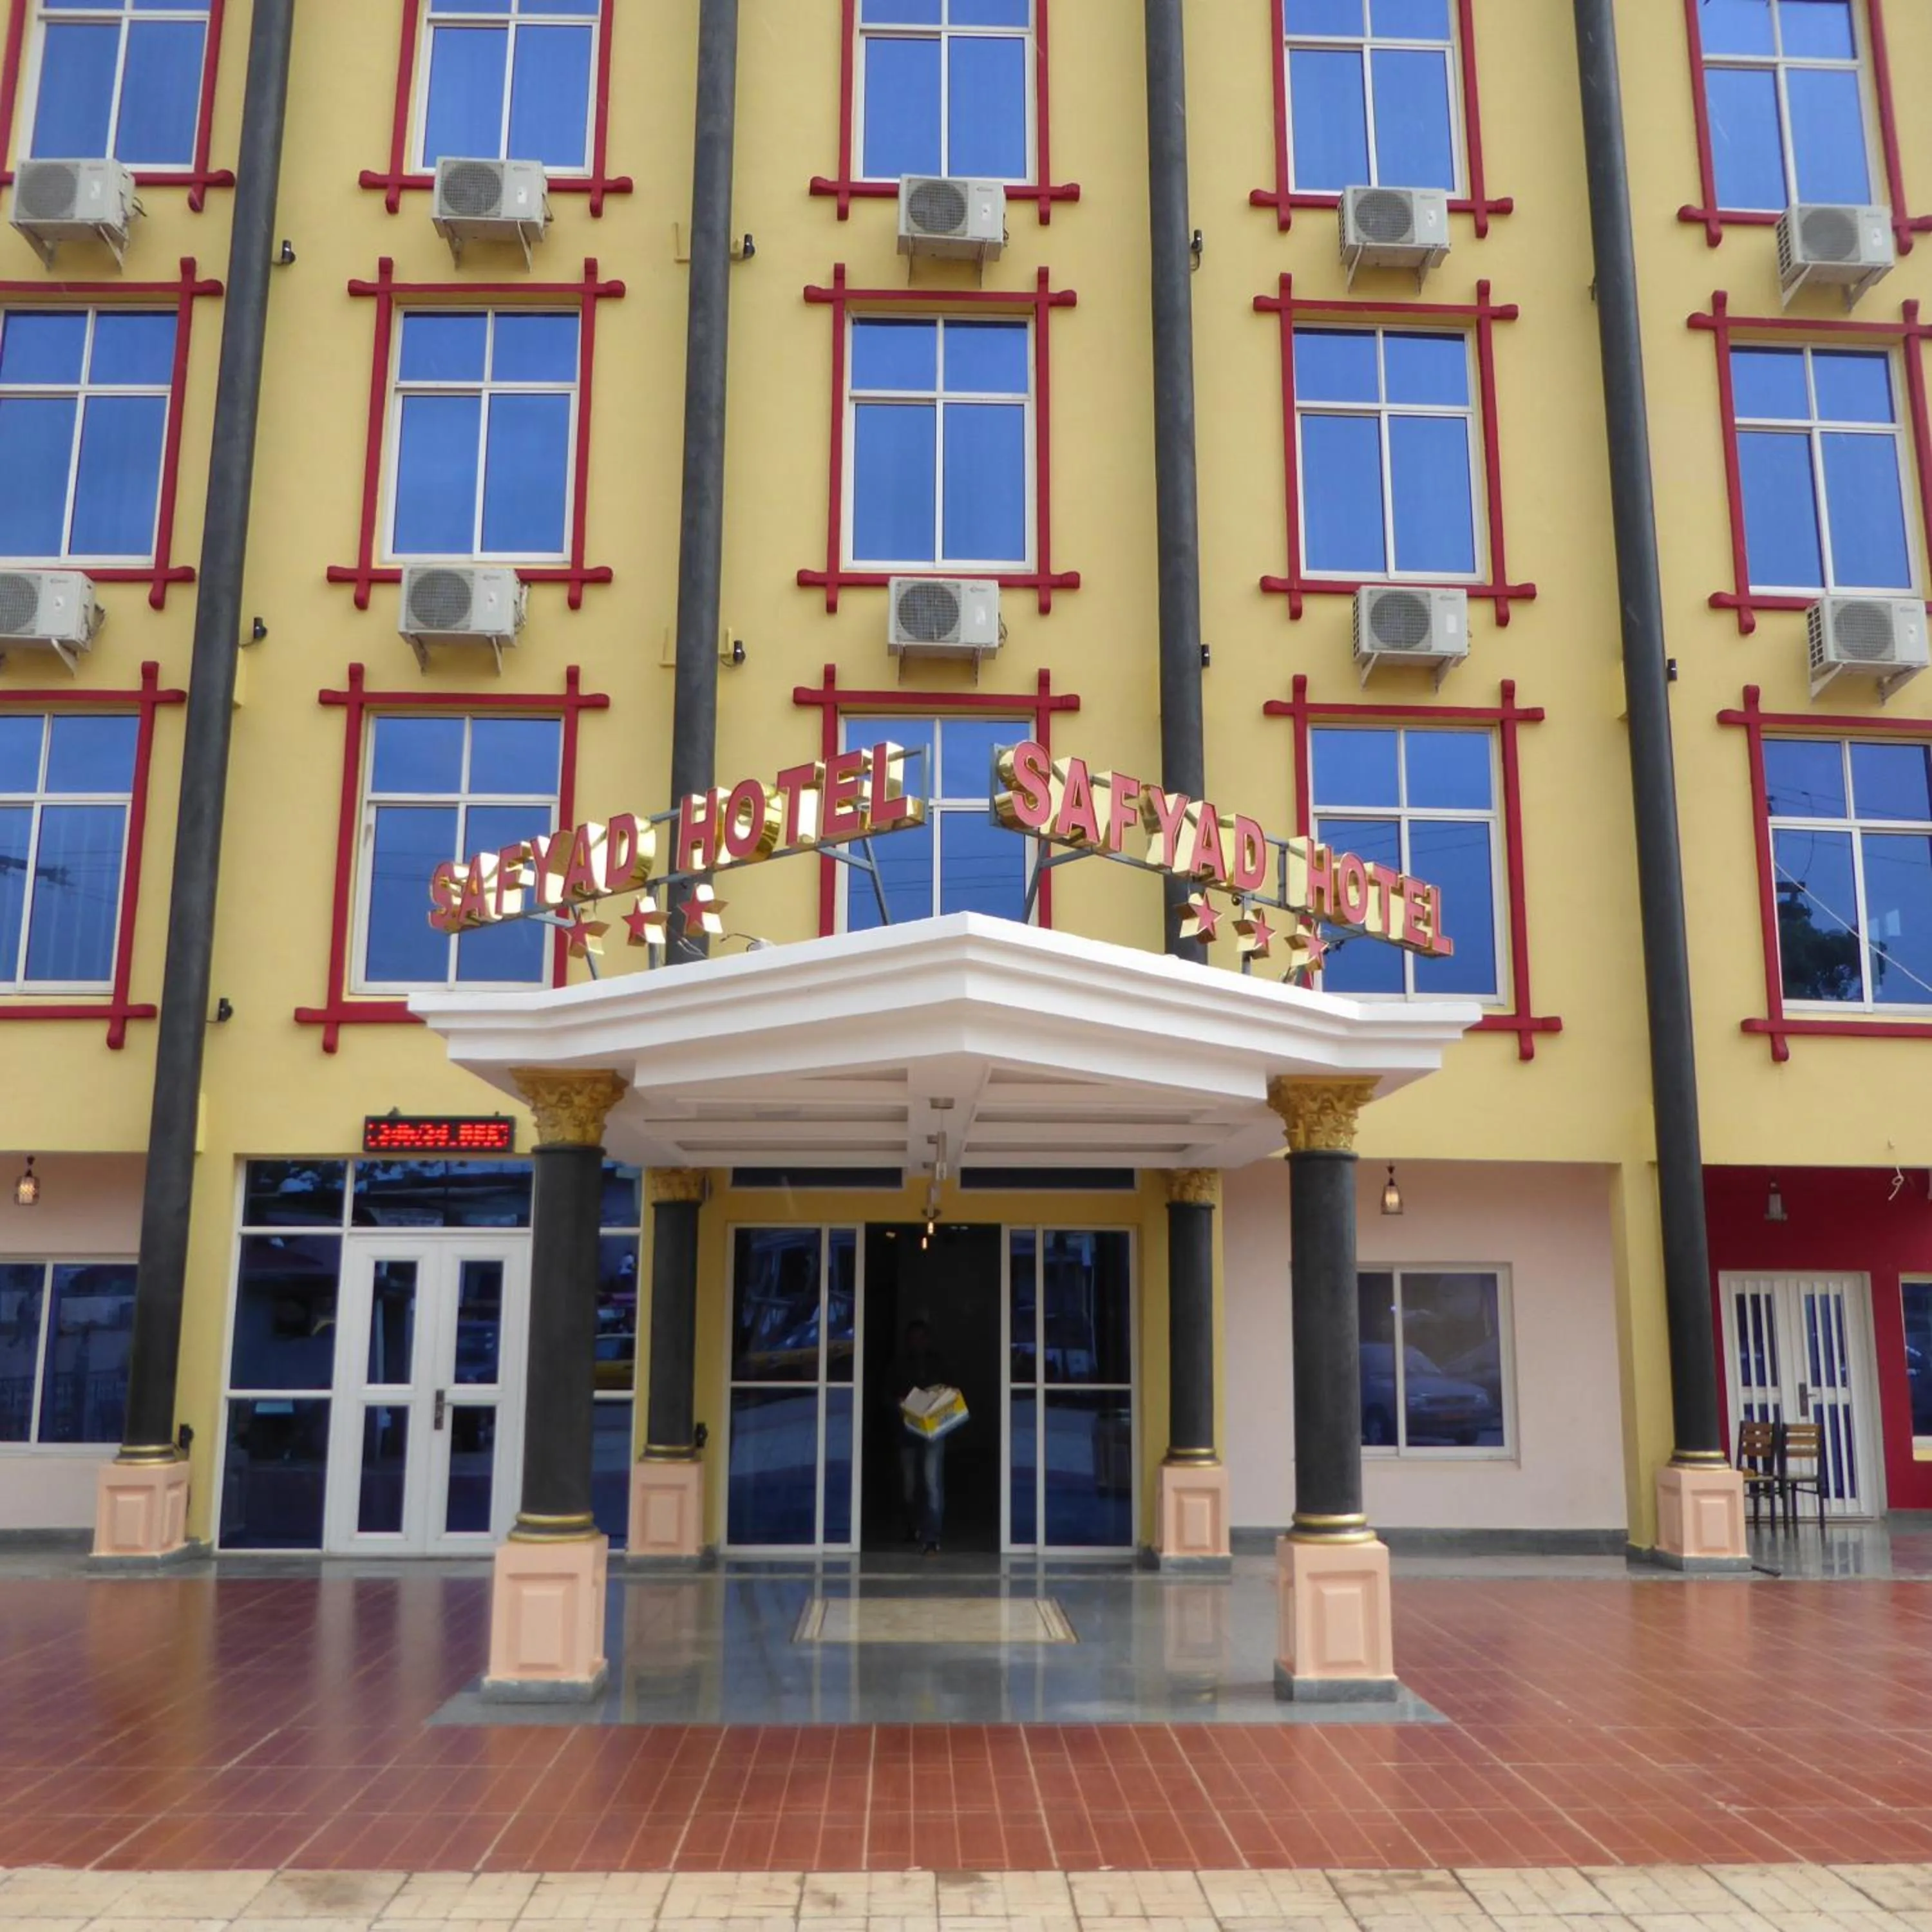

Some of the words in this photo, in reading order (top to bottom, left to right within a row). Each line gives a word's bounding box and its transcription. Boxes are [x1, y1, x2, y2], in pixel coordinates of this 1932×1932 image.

[428, 813, 650, 933] SAFYAD
[676, 741, 920, 873] HOTEL
[1003, 740, 1267, 892] SAFYAD
[1298, 837, 1454, 956] HOTEL
